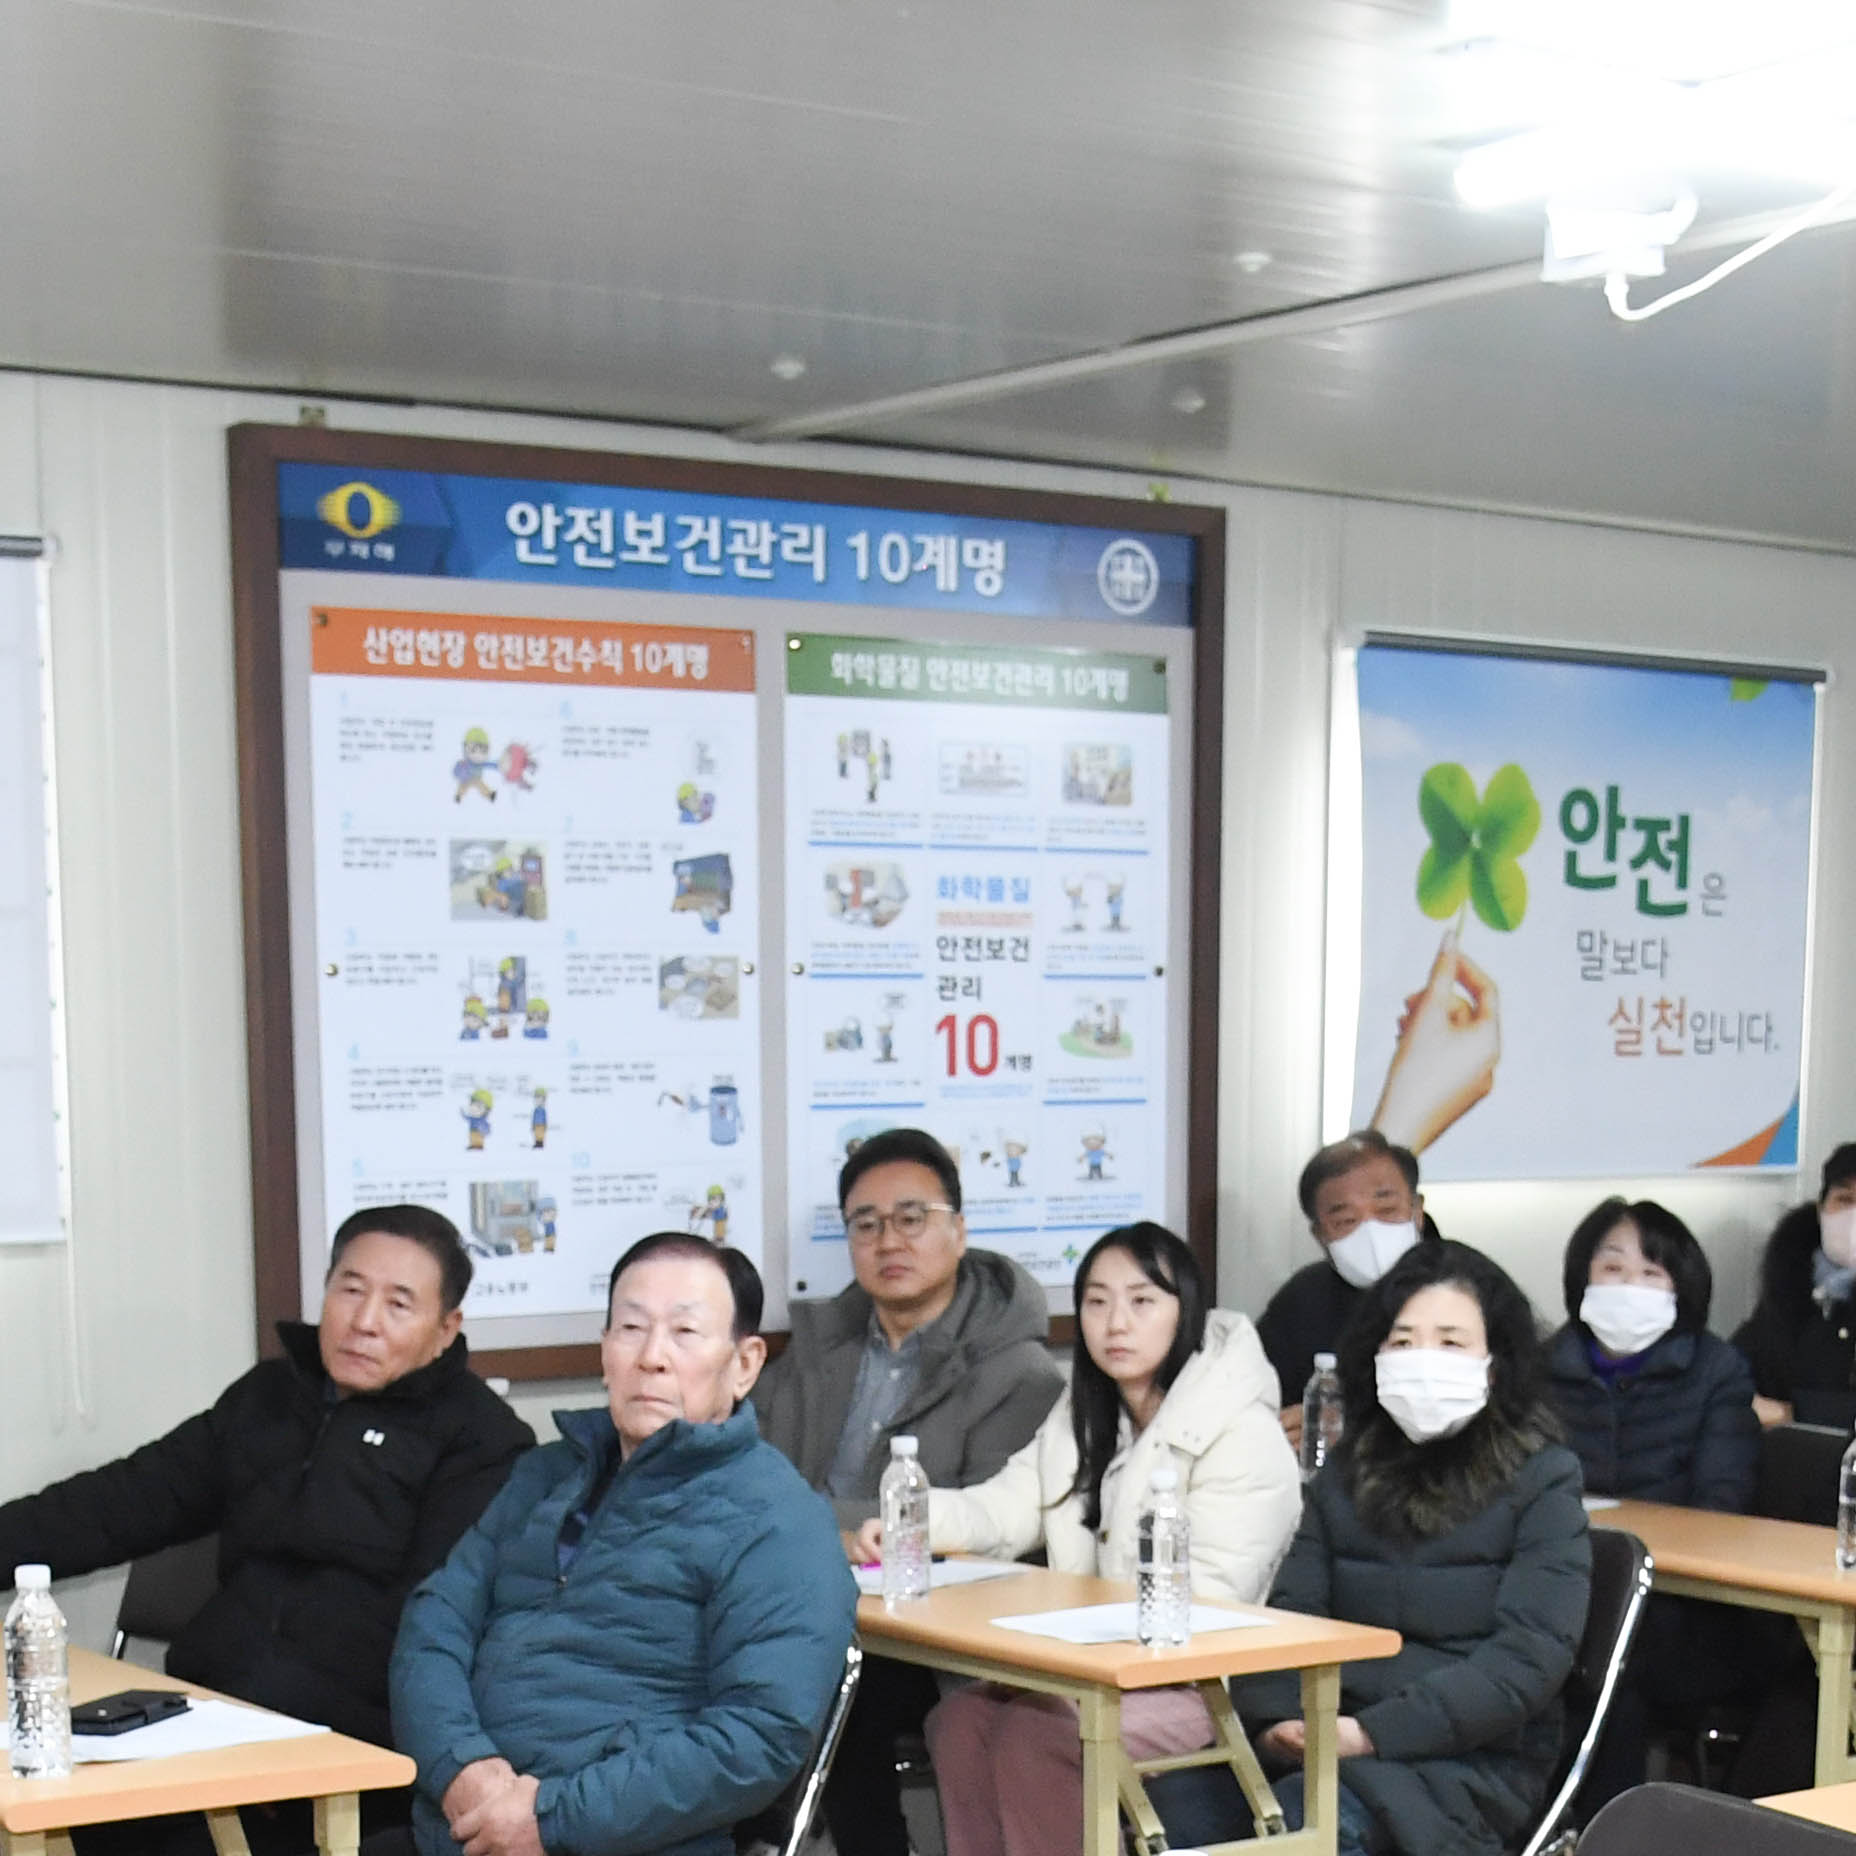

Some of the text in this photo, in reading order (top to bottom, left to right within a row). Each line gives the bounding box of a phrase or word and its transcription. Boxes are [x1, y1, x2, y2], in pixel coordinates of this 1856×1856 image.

[505, 502, 1007, 597] 안전보건관리 10계명
[363, 626, 710, 680] 산업현장 안전보건수칙 10계명
[1060, 666, 1130, 703] 10계명
[1557, 783, 1728, 918] 안전은
[938, 875, 1030, 903] 화학물질
[936, 935, 1030, 963] 안전보건
[1575, 929, 1671, 982] 말보다
[936, 975, 982, 1002] 관리
[935, 1013, 999, 1078] 10
[1606, 995, 1780, 1059] 실천입니다.
